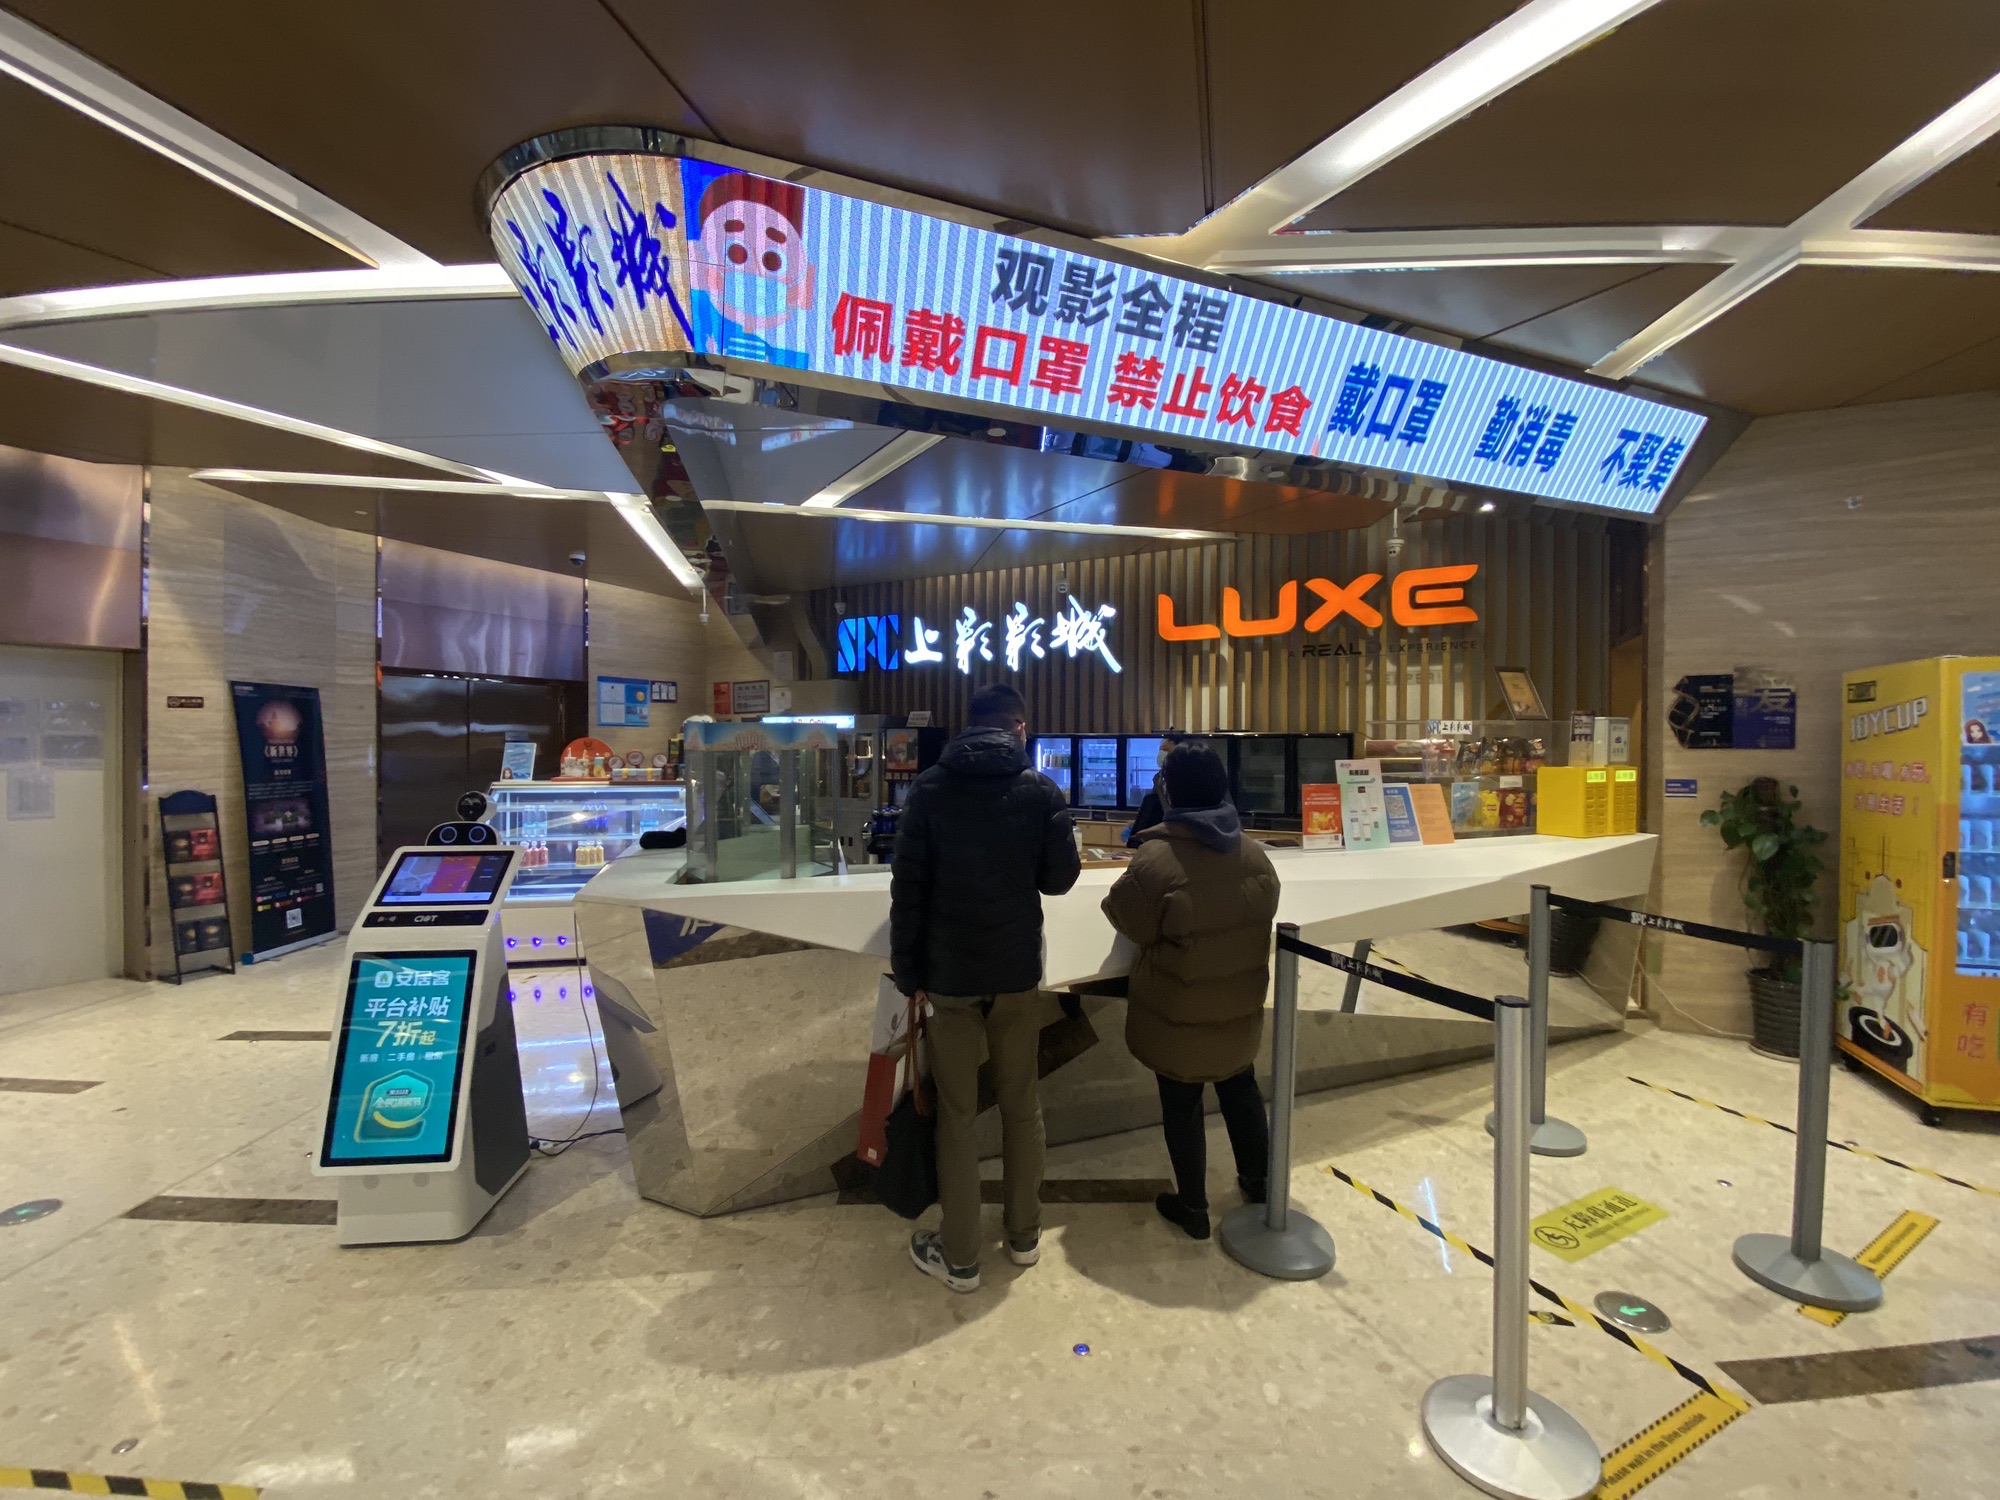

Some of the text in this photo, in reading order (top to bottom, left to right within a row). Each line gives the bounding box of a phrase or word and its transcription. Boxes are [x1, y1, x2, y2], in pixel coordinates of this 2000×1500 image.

[991, 249, 1230, 355] 观影全程
[832, 292, 1313, 439] 佩戴口罩 禁止饮食
[1327, 362, 1685, 495] 戴口罩 勤消毒 不聚集
[1157, 563, 1479, 641] LUXE
[837, 594, 1122, 674] SFC 上影影城
[1389, 640, 1478, 653] EXPERIENCE
[1850, 697, 1927, 741] JOYCUP
[395, 969, 450, 987] 安居客
[364, 996, 451, 1018] 平台补贴
[376, 1020, 436, 1048] 7折起
[1562, 1195, 1638, 1232] 无障碍通道
[1600, 1467, 1630, 1488] Please
[1627, 1454, 1648, 1470] wait
[1651, 1440, 1668, 1453] the
[1661, 1430, 1682, 1444] line
